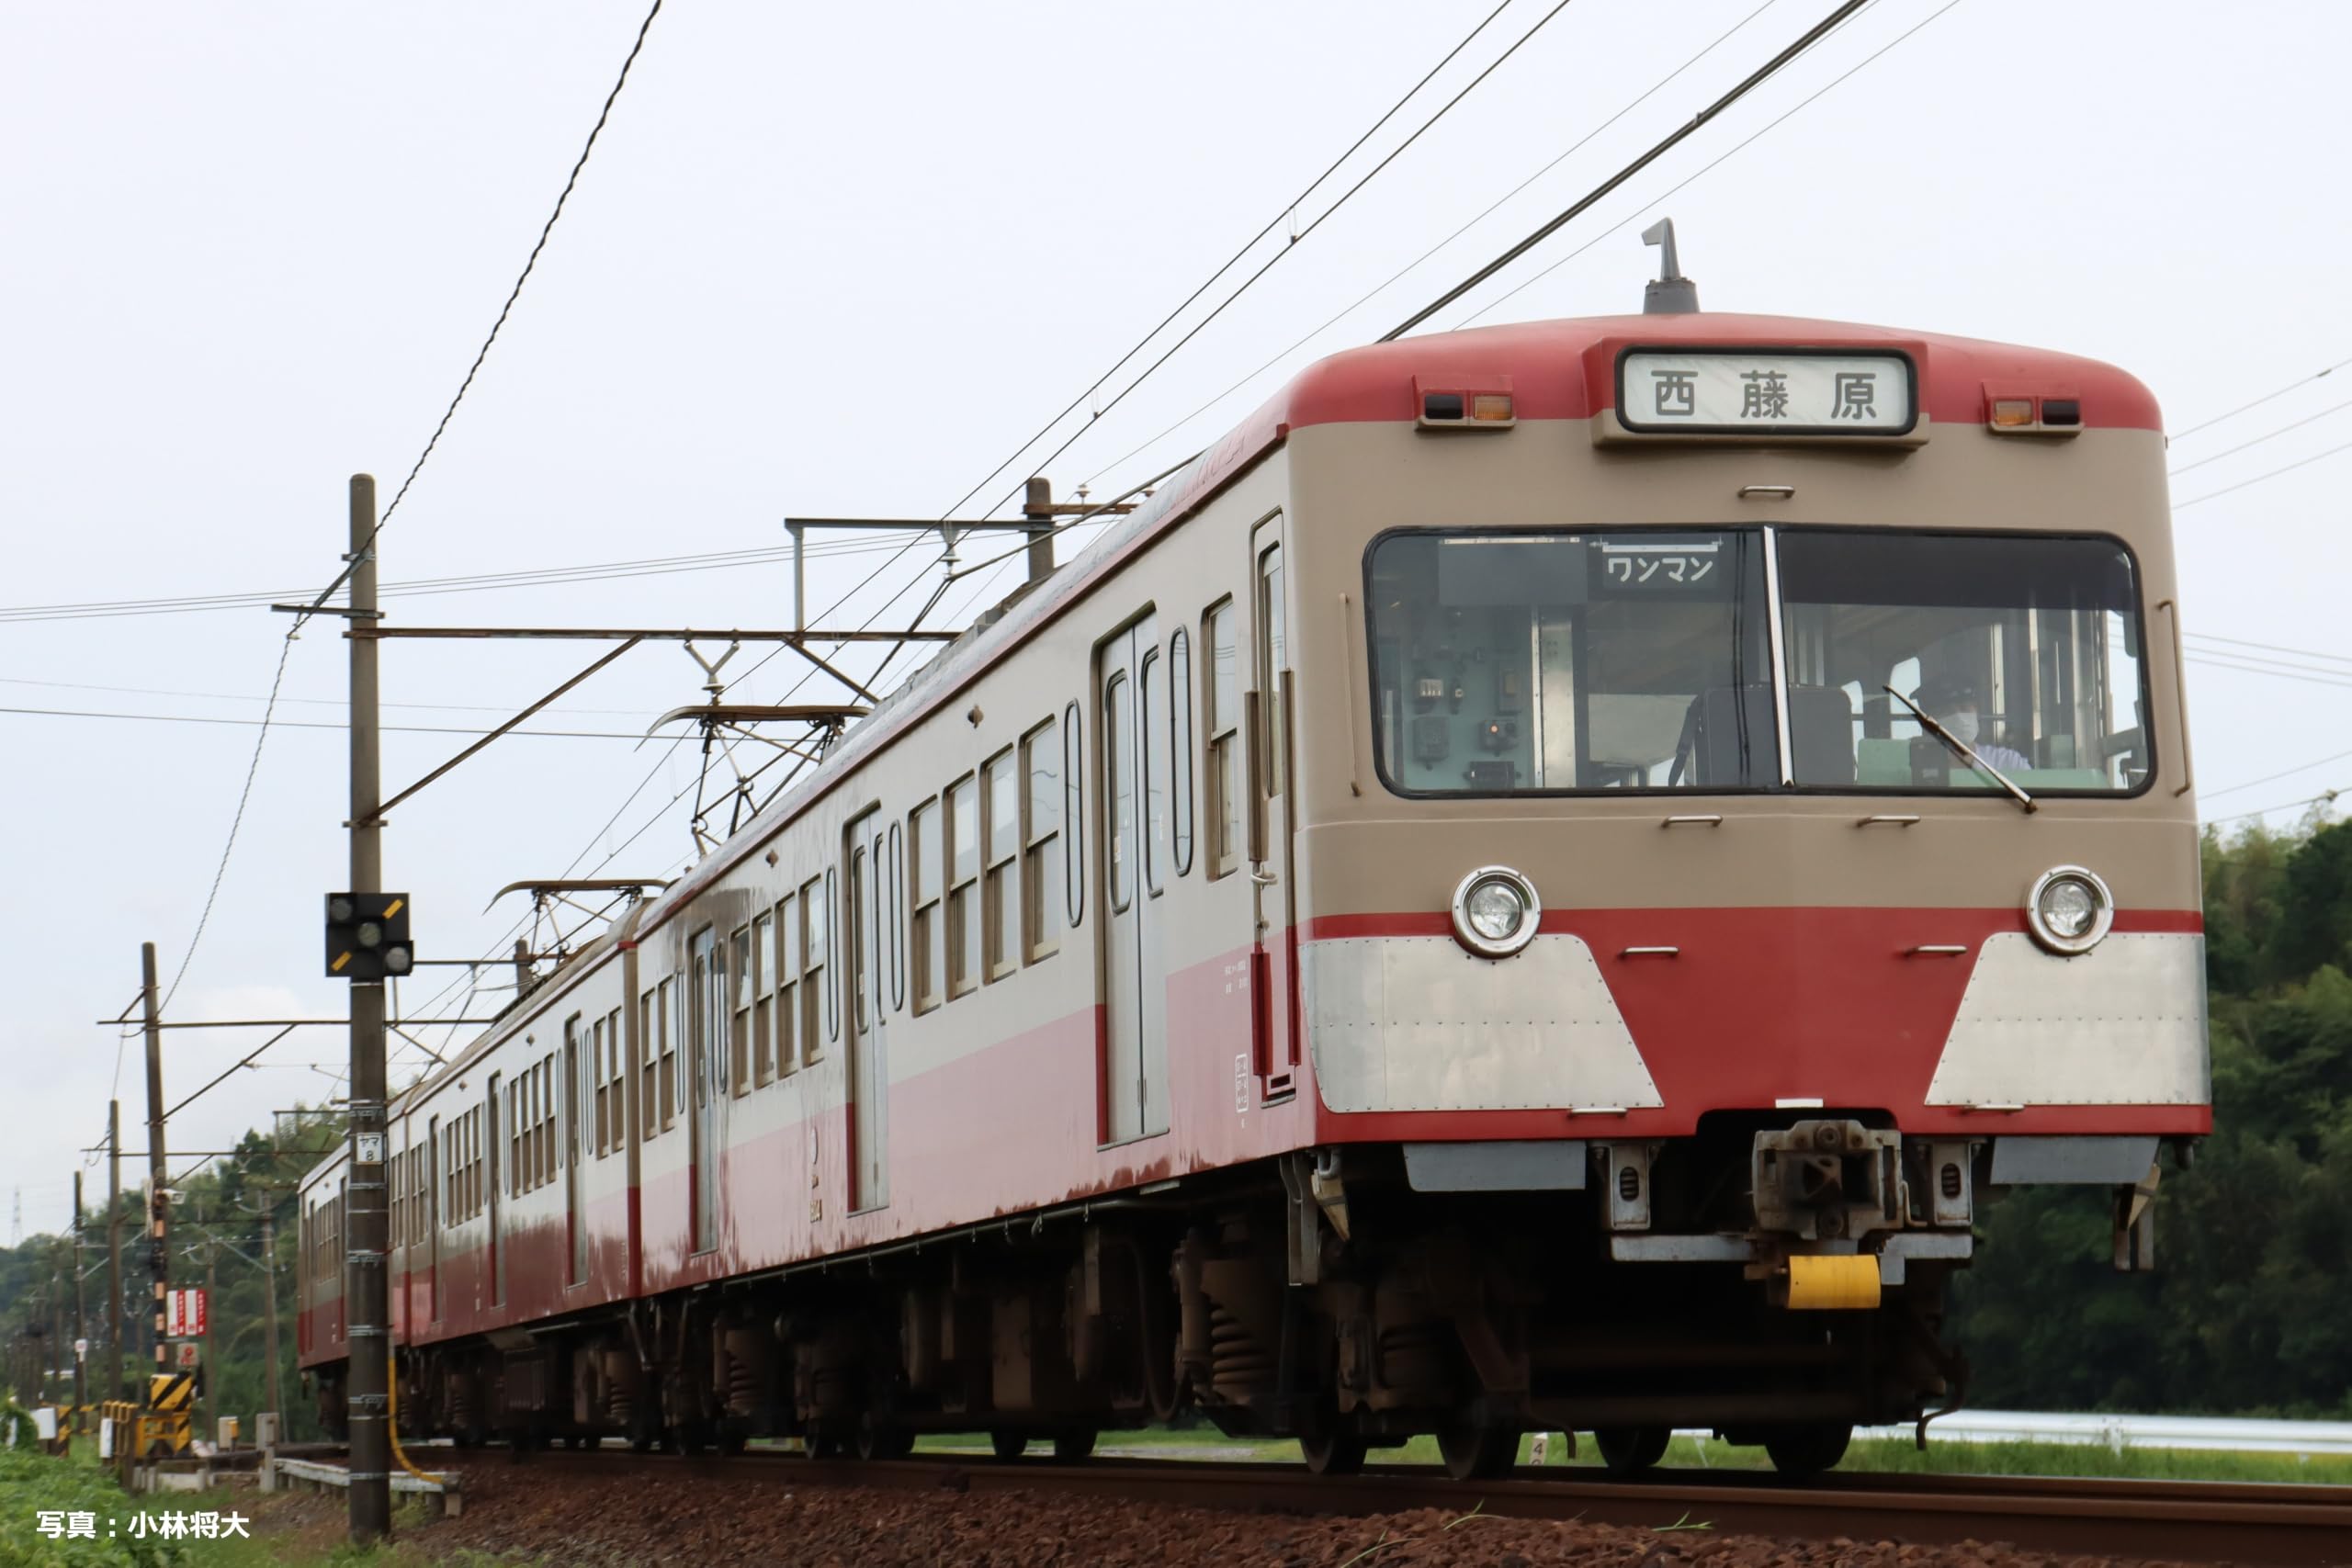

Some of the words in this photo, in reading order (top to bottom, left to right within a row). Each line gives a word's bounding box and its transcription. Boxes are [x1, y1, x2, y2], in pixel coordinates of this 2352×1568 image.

[1651, 369, 1877, 420] 西藤原
[1608, 557, 1713, 582] ワンマン
[366, 1150, 374, 1162] 8
